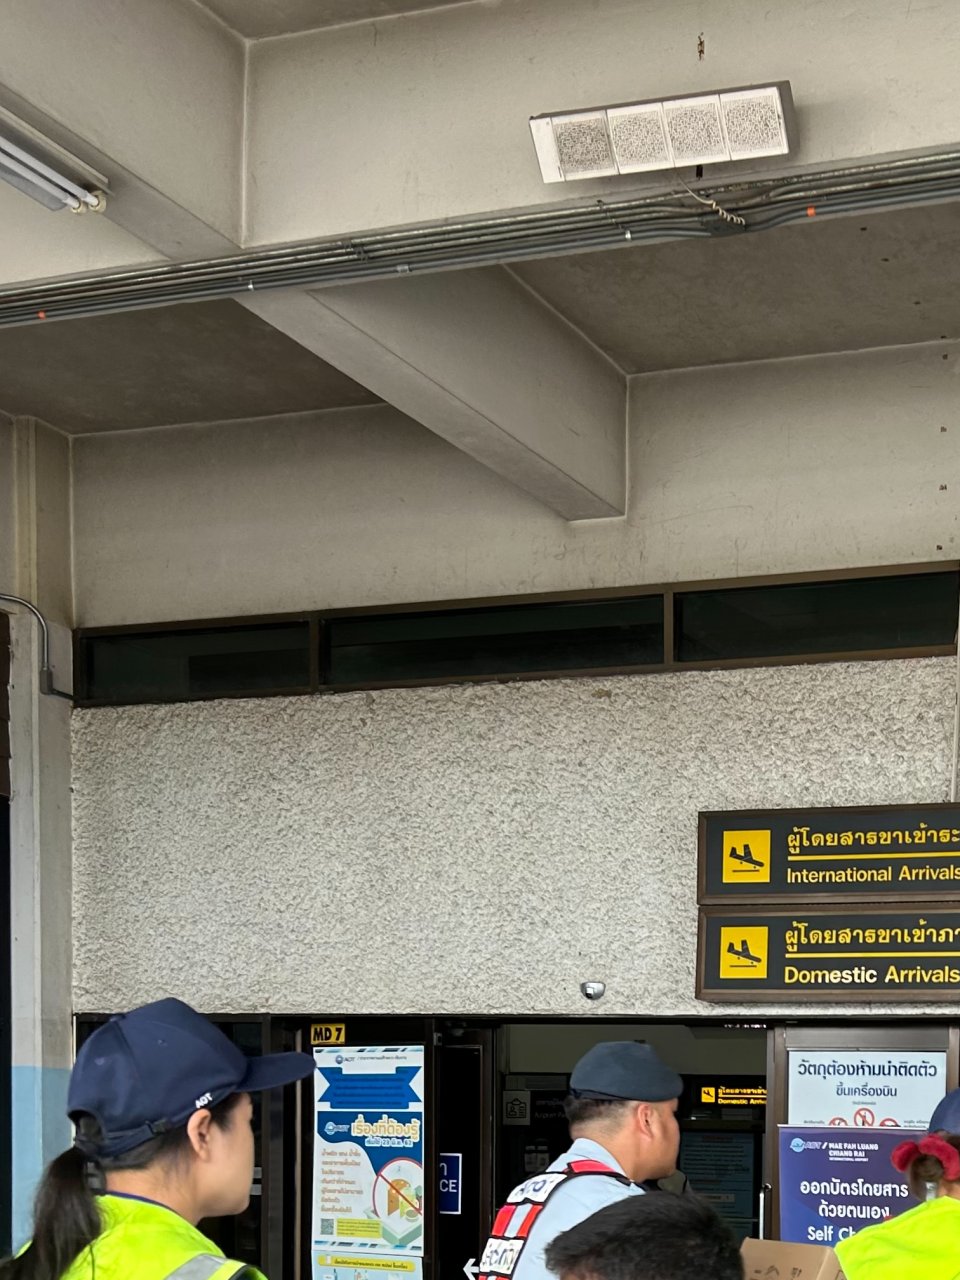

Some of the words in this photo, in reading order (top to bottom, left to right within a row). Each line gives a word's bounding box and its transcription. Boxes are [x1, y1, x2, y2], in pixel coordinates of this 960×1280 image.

[787, 866, 892, 883] International
[784, 965, 877, 983] Domestic
[885, 965, 960, 983] Arrivals
[313, 1028, 332, 1041] MD
[335, 1027, 343, 1041] 7
[798, 1060, 937, 1080] วัตถุต้องห้ามนำติดตัว
[836, 1081, 897, 1097] ขึ้นเครื่องบิน
[800, 1177, 909, 1197] ออกบัตรโดยสาร
[818, 1199, 890, 1218] ด้วยตนเอง
[807, 1226, 834, 1241] Self
